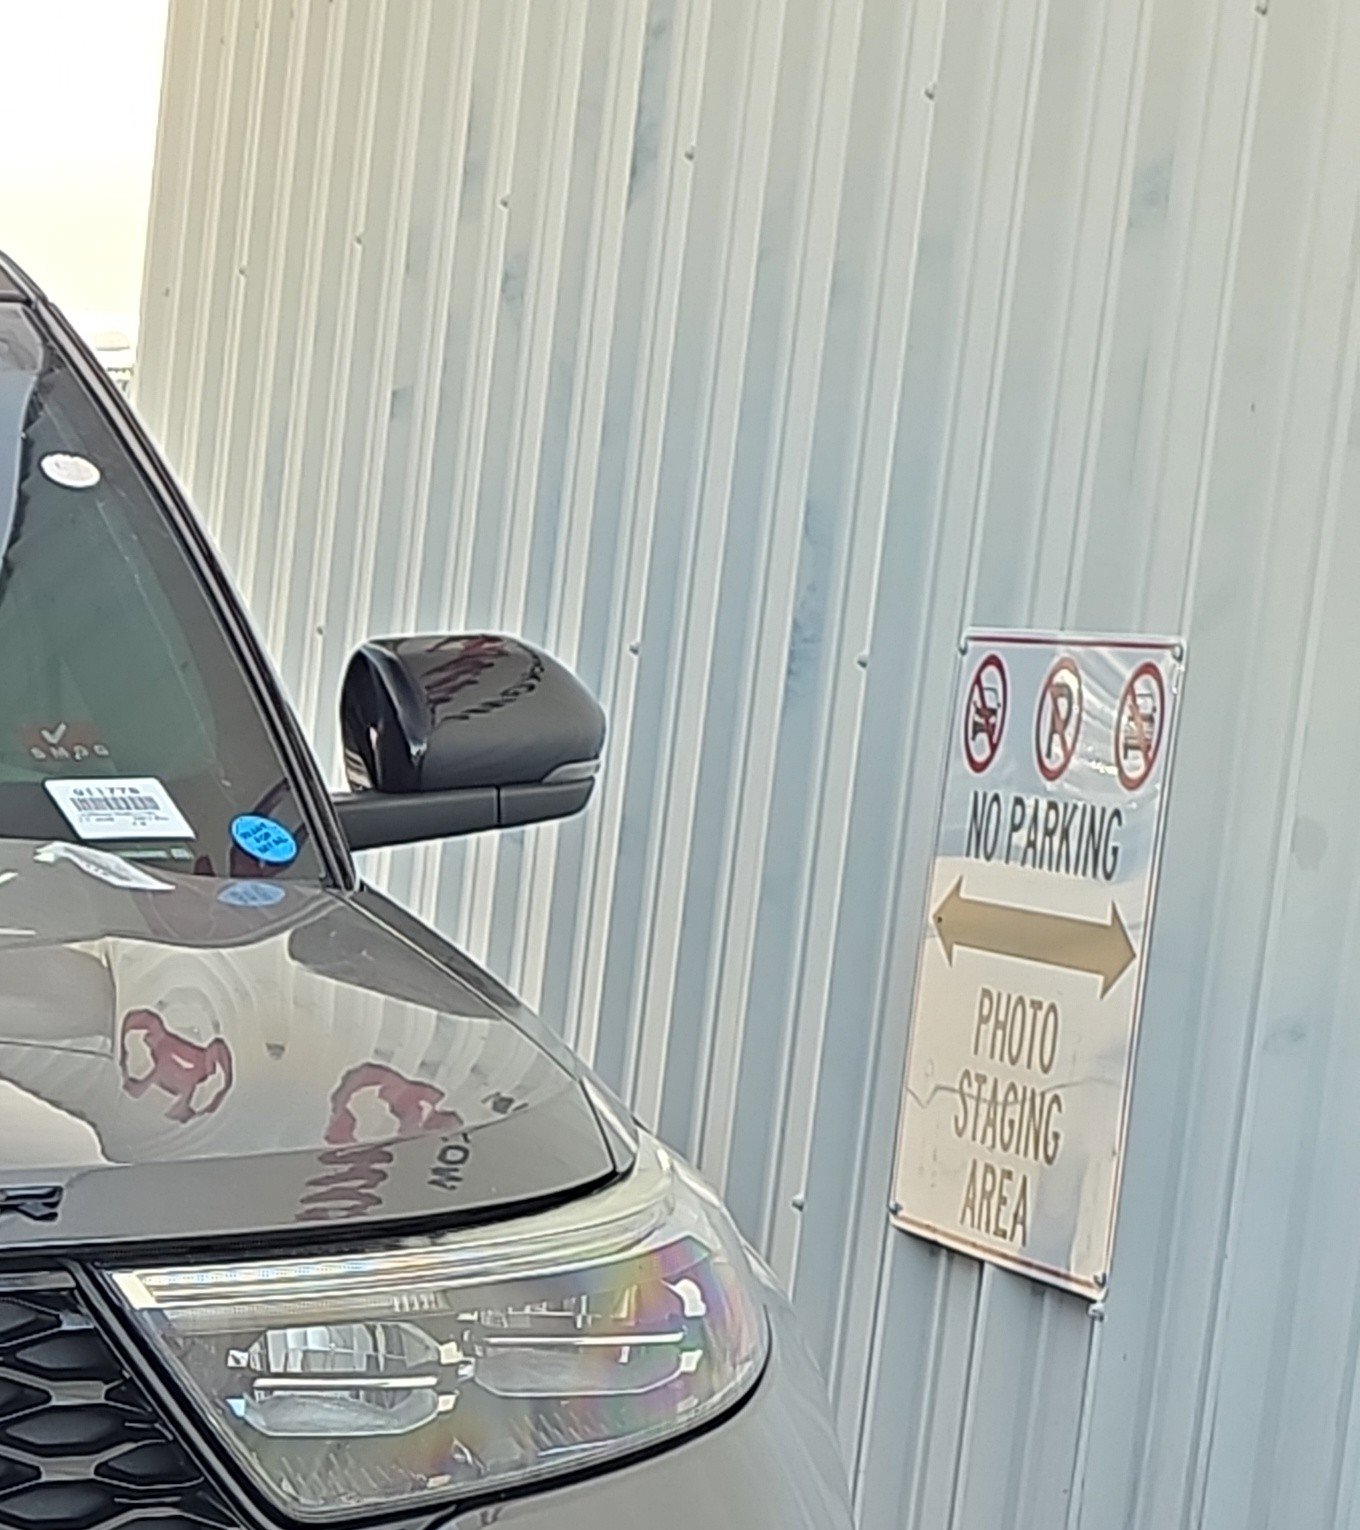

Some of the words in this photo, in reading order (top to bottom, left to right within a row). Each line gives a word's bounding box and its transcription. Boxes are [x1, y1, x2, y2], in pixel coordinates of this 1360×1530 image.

[965, 790, 1002, 862] NO
[1005, 796, 1123, 882] PARKING
[973, 987, 1059, 1075] PHOTO
[954, 1068, 1063, 1166] STAGING
[960, 1158, 1028, 1248] AREA
